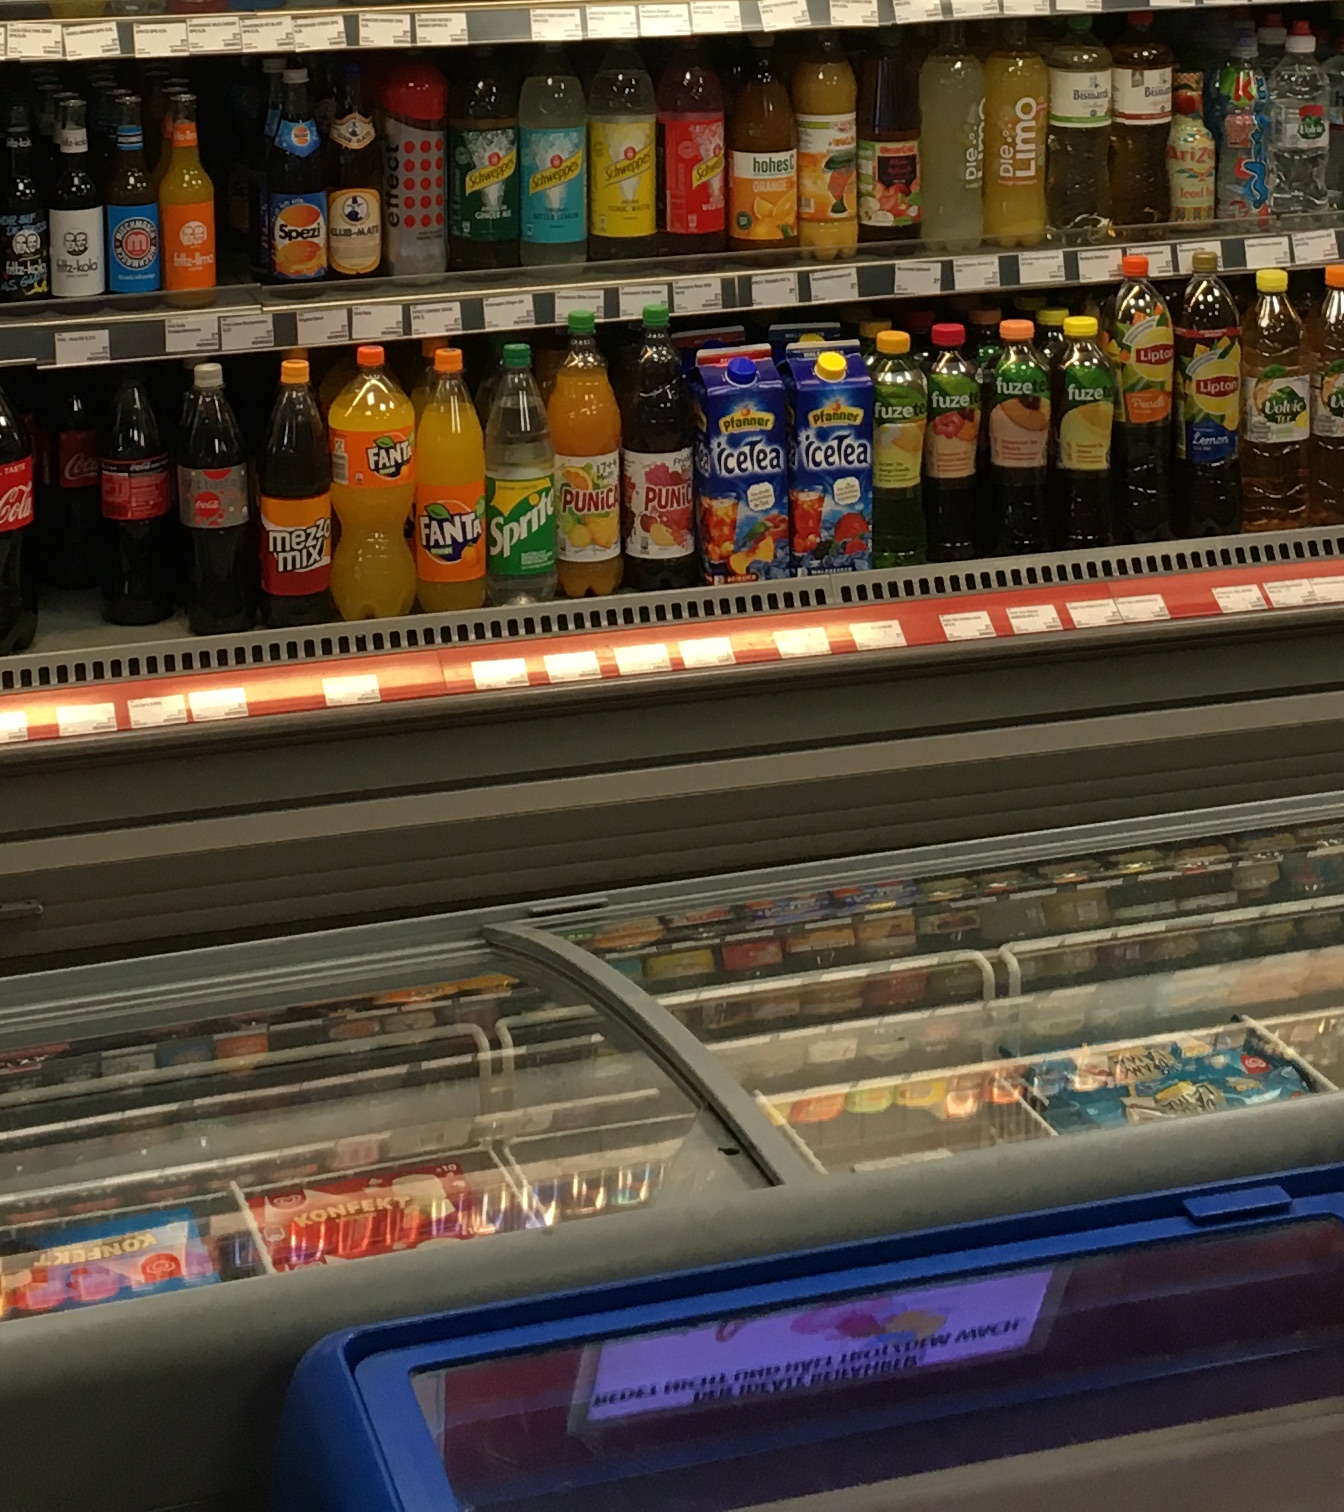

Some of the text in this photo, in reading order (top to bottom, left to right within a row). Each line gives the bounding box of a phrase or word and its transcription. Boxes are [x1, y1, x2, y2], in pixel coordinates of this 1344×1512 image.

[752, 156, 781, 174] hohes
[278, 223, 322, 240] Spezi
[721, 413, 773, 432] Pfanner
[812, 409, 863, 427] Pfanner
[1192, 430, 1231, 447] Lemon
[4, 463, 27, 476] TASTE
[420, 511, 484, 548] FANTA
[490, 491, 555, 558] Sprite
[269, 517, 330, 552] mezzo
[278, 542, 325, 574] mix
[292, 1194, 413, 1230] KONFEKT
